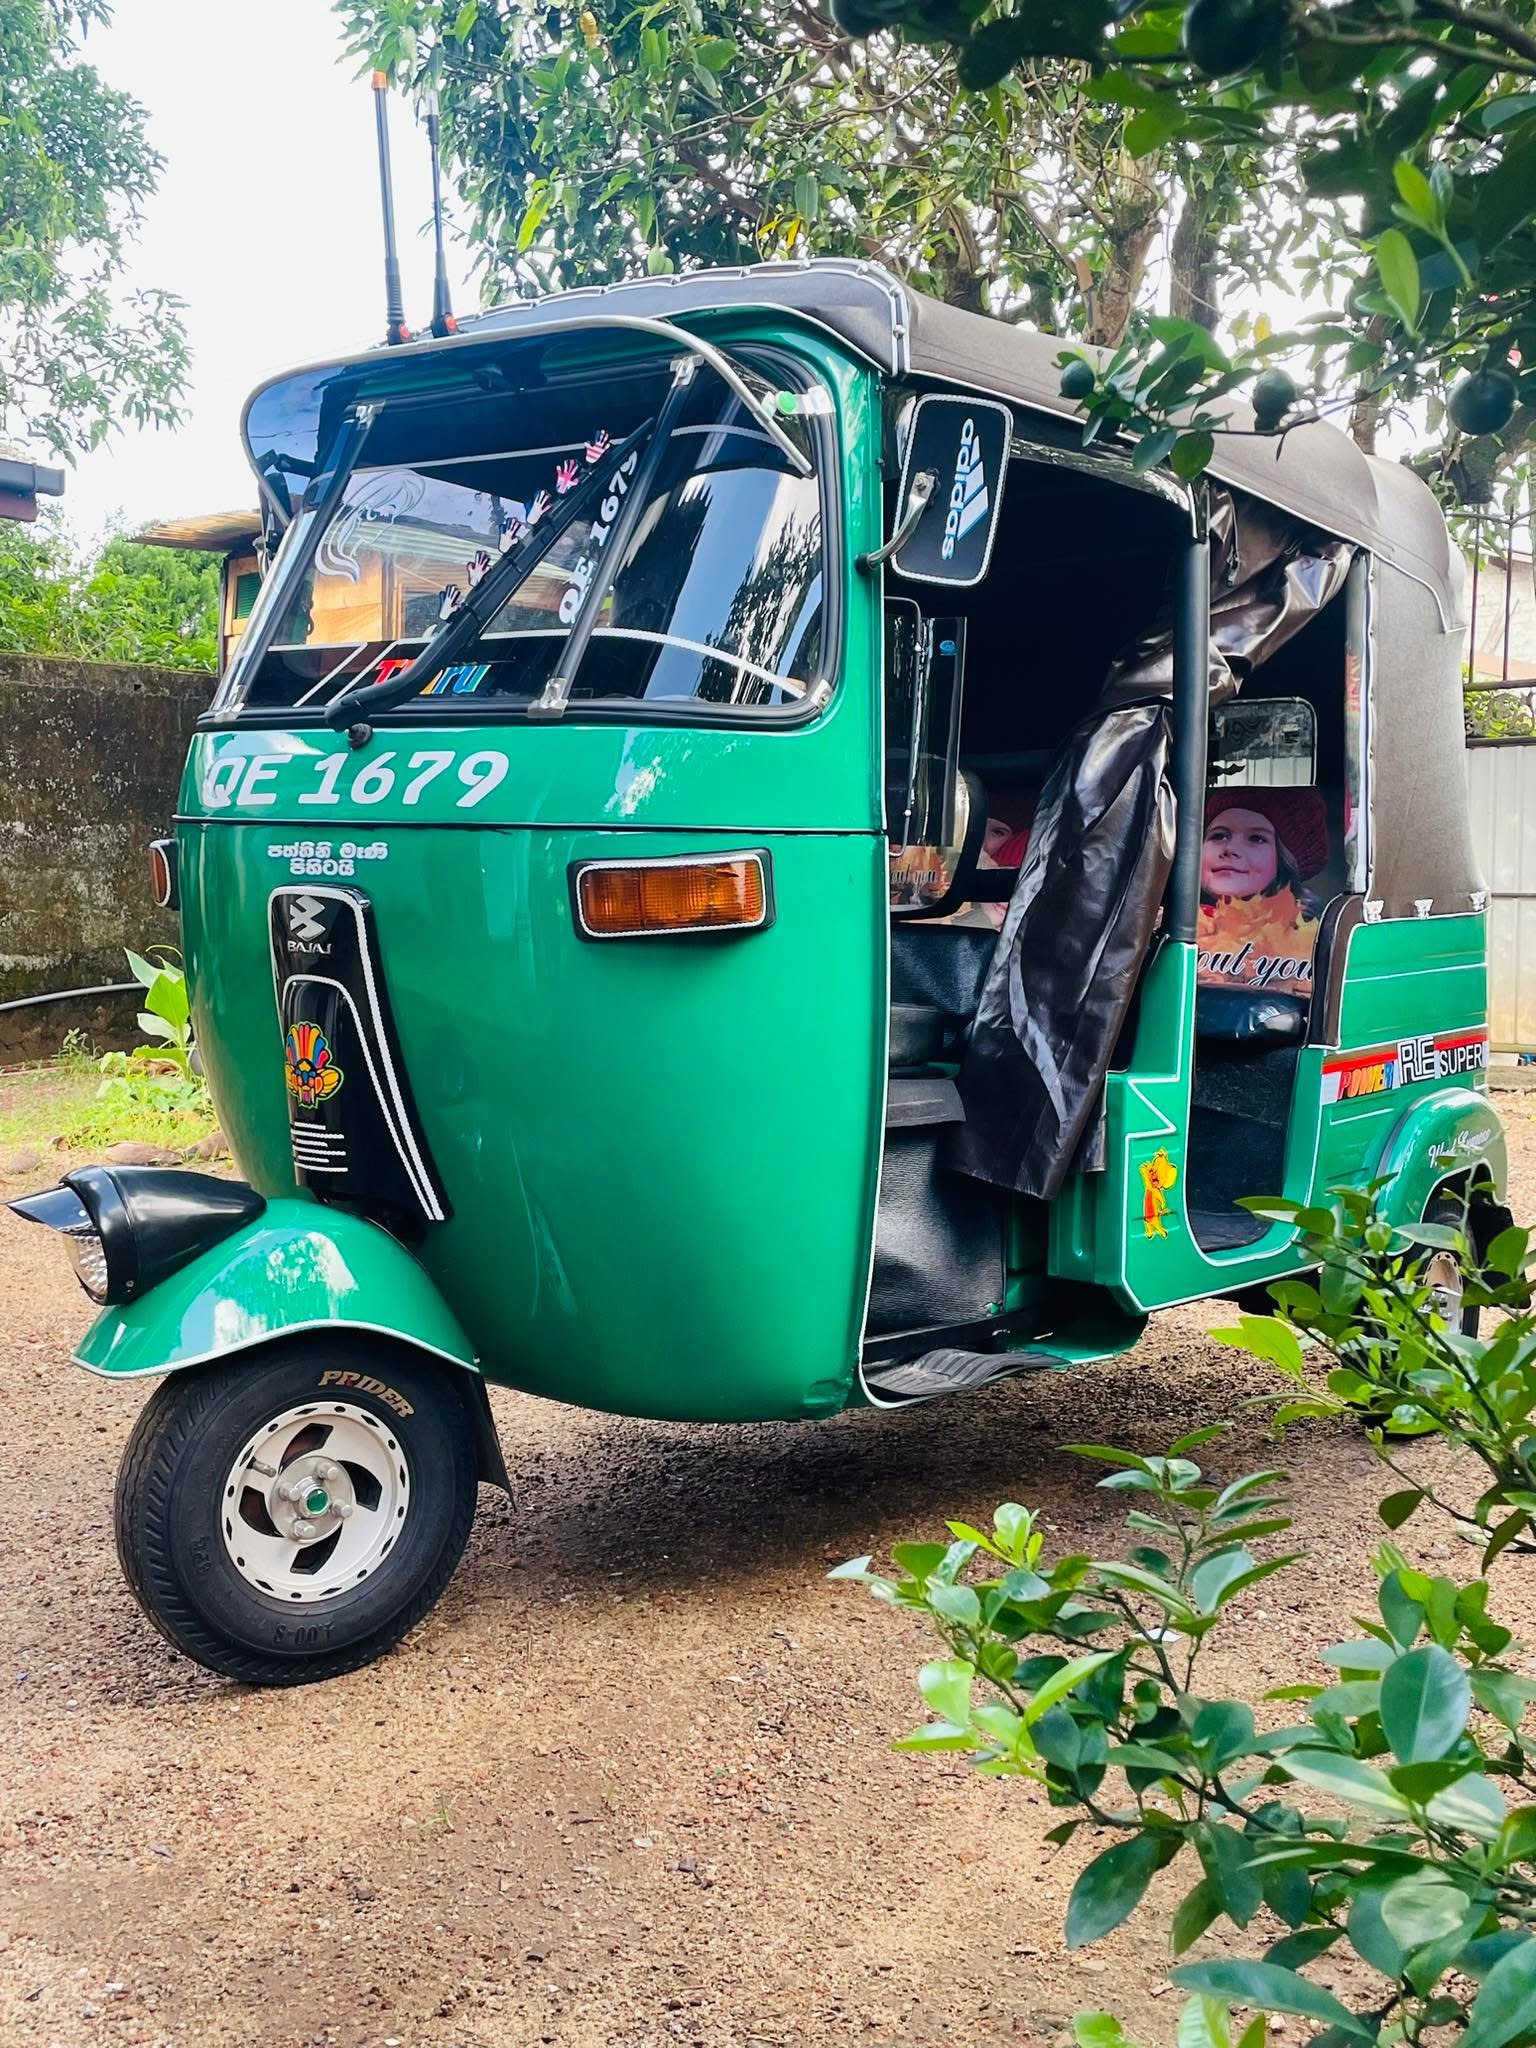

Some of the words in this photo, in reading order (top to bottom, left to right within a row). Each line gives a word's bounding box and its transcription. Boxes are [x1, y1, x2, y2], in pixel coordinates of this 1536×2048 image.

[941, 418, 975, 561] adidas
[558, 555, 597, 624] QE
[203, 754, 294, 808] QE
[298, 750, 510, 808] 1679
[287, 940, 332, 955] BAJAJ
[1337, 1060, 1395, 1101] POWER
[1397, 1036, 1436, 1085] RE
[1440, 1043, 1484, 1076] SUPER
[318, 1370, 415, 1418] PRIDER
